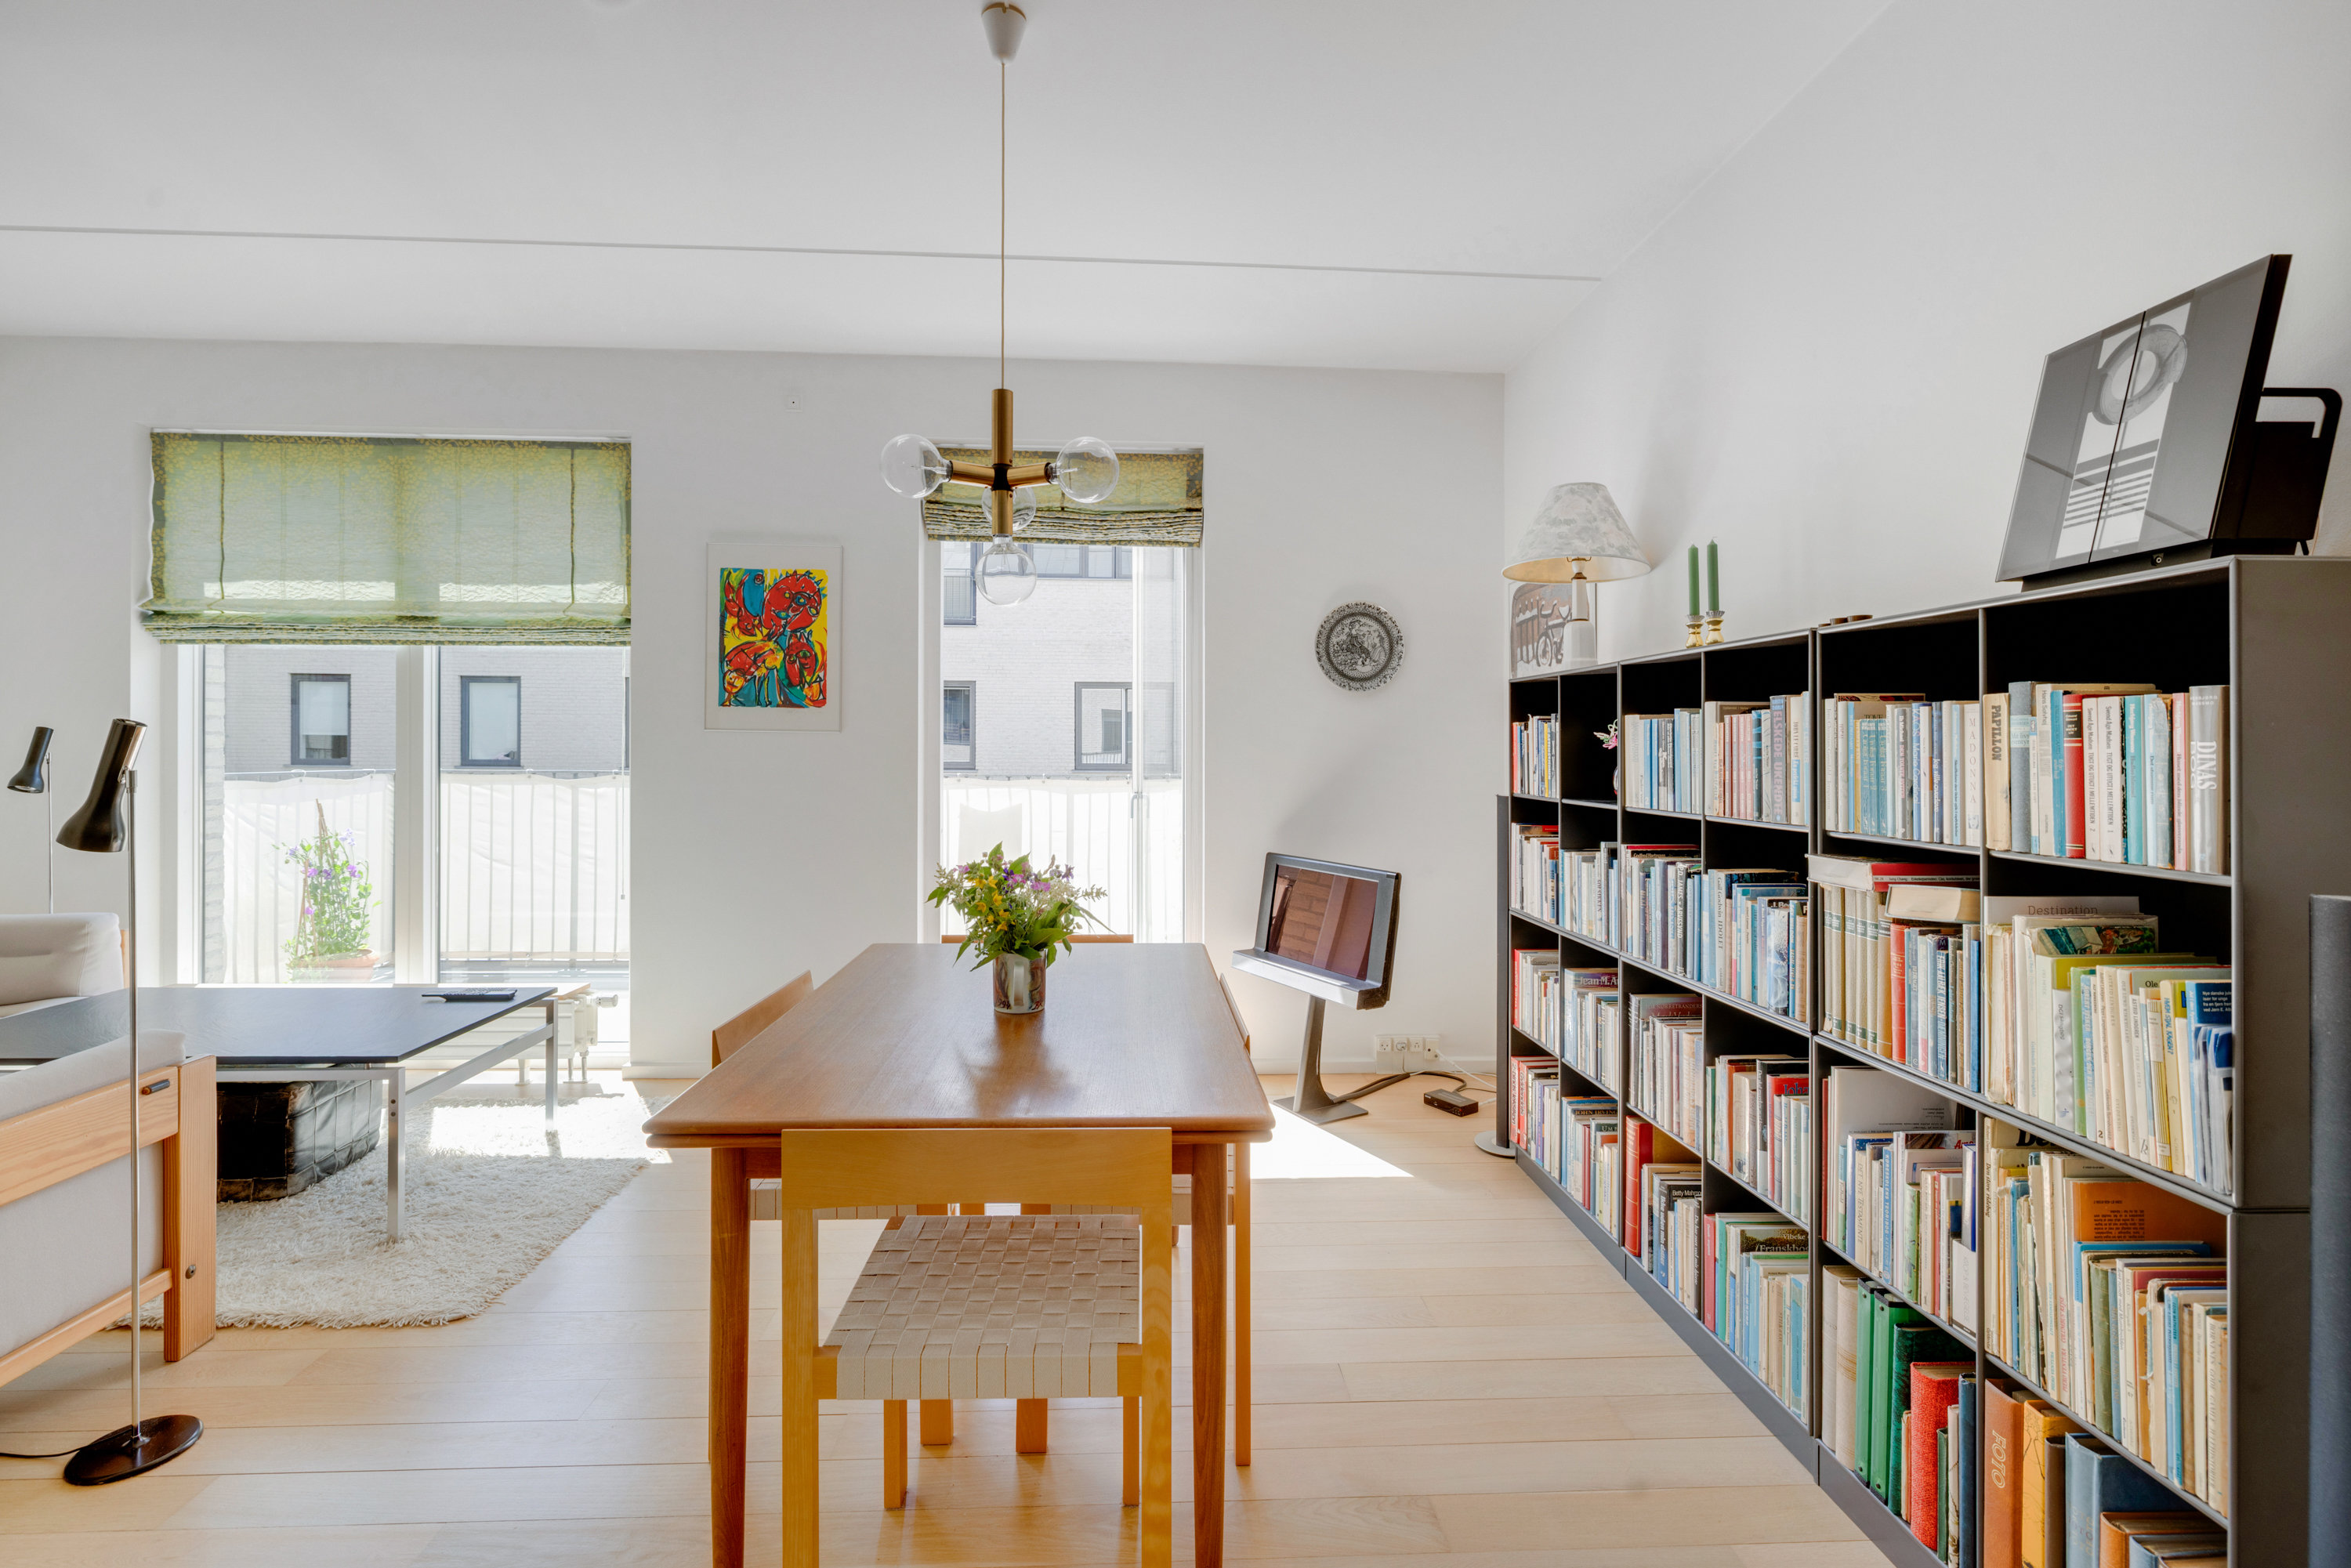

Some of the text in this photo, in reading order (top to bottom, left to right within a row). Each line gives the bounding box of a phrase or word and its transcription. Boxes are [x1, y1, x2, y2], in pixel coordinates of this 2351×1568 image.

[1773, 711, 1783, 758] ELSKEDE
[1991, 705, 2001, 761] PAPILLON
[2196, 741, 2217, 790] DINAS
[2028, 905, 2098, 915] Destination
[1610, 976, 1619, 986] A
[2099, 1130, 2103, 1139] 2
[1992, 1429, 2006, 1489] FOTO
